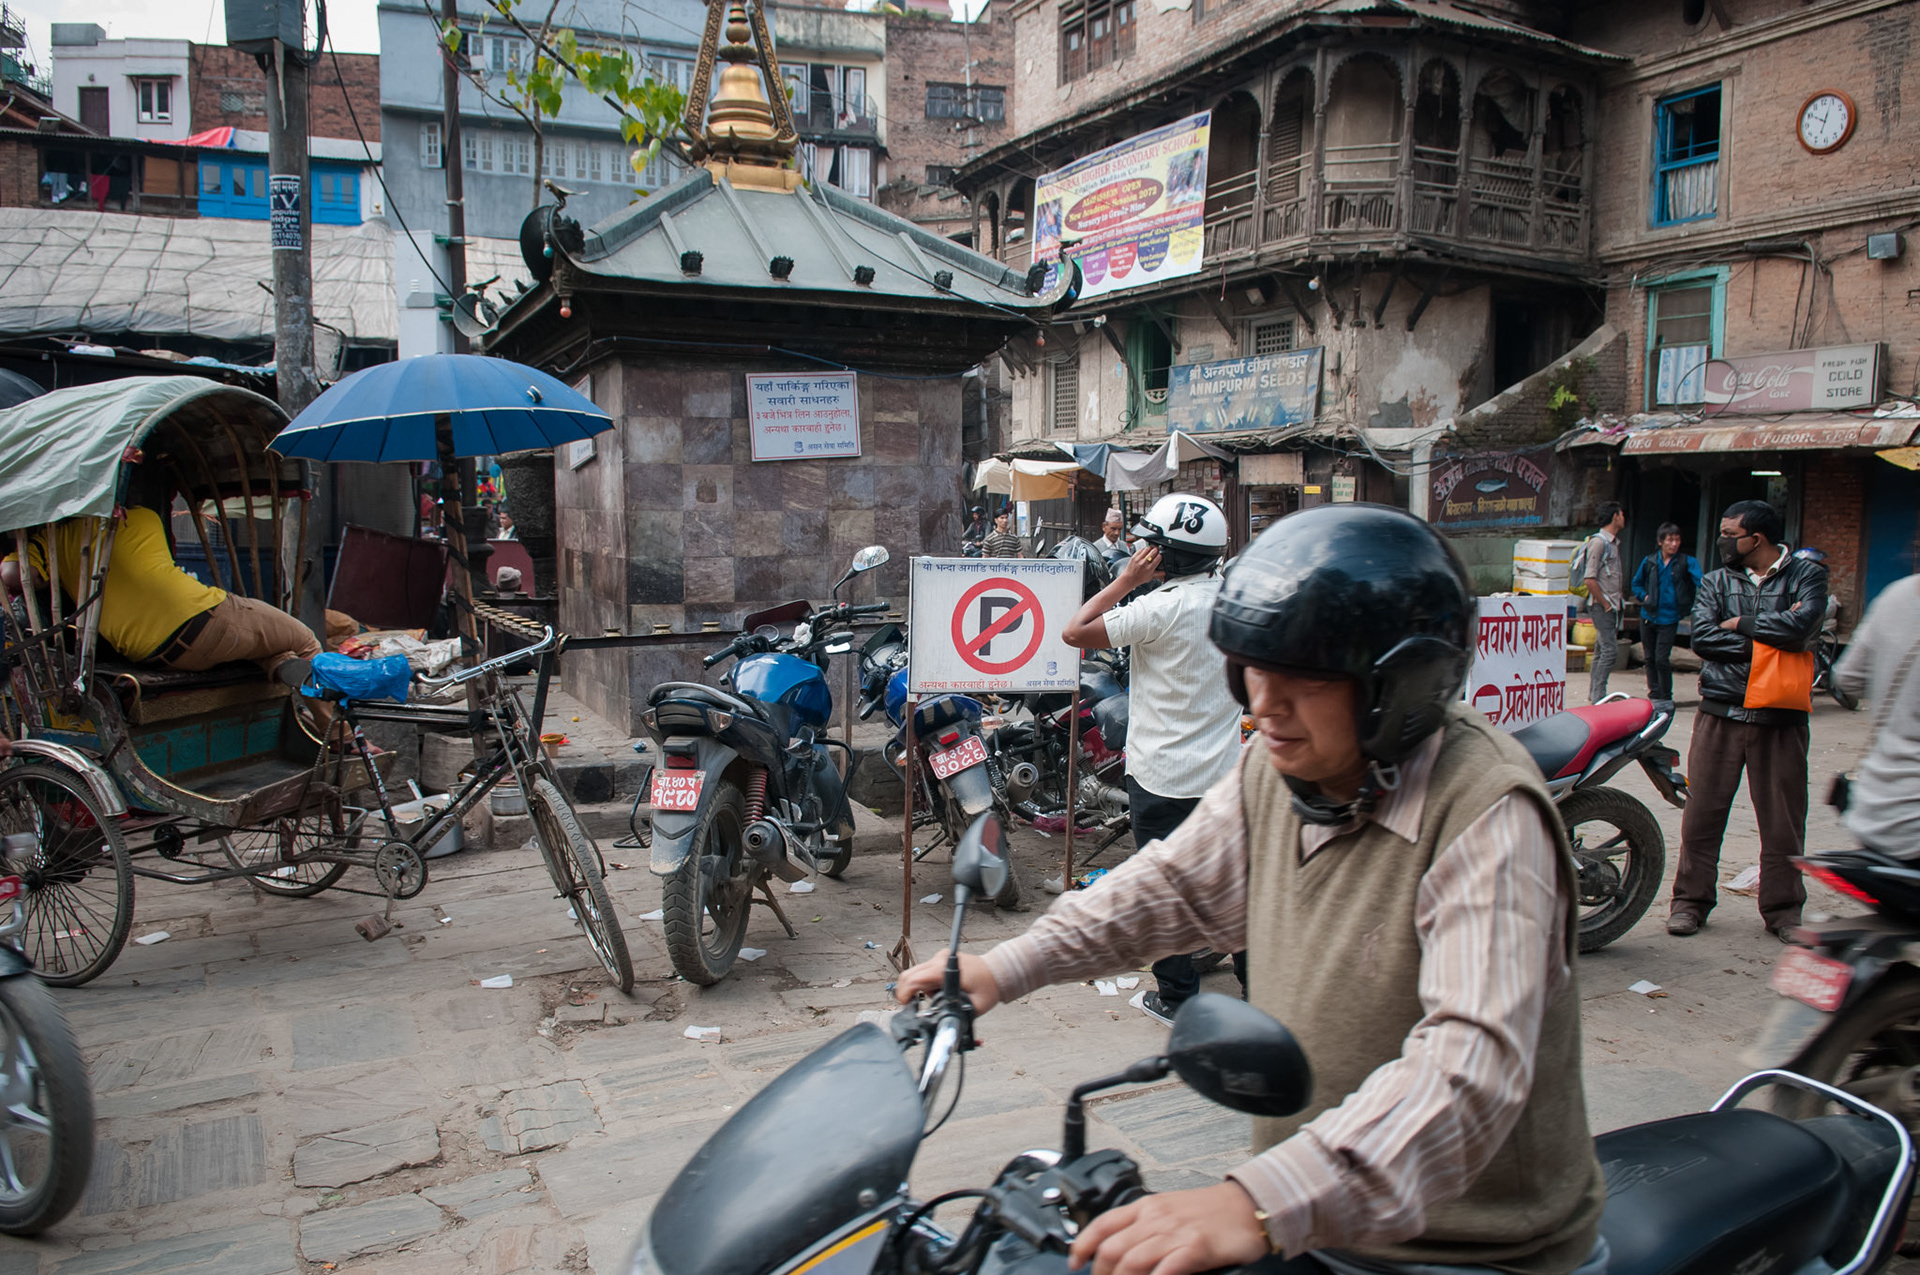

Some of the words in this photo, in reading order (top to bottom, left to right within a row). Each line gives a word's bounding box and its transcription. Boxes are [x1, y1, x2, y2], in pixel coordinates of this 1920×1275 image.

[1081, 164, 1111, 184] HIGHER
[1112, 144, 1160, 172] SECONDARY
[1162, 132, 1200, 155] SCHOOL
[1121, 180, 1142, 193] OPEN
[1077, 215, 1102, 229] Nursery
[1101, 213, 1108, 222] to
[1109, 206, 1129, 219] Grade
[1129, 202, 1147, 213] Nine
[1828, 370, 1863, 383] COLD
[754, 380, 773, 393] यहाँ
[813, 379, 850, 392] गरिएका
[1189, 376, 1257, 397] ANNAPURNA
[1259, 370, 1306, 388] SEEDS
[1826, 386, 1863, 399] STORE
[767, 395, 796, 406] सवारी
[922, 561, 933, 572] यो
[936, 564, 955, 573] भन्दा
[958, 562, 987, 573] अगाडि
[1476, 601, 1520, 661] सवारी
[1521, 613, 1564, 656] साधन
[919, 680, 948, 690] अन्यथा
[1502, 673, 1536, 726] प्रवेश
[1535, 668, 1566, 721] निषेध
